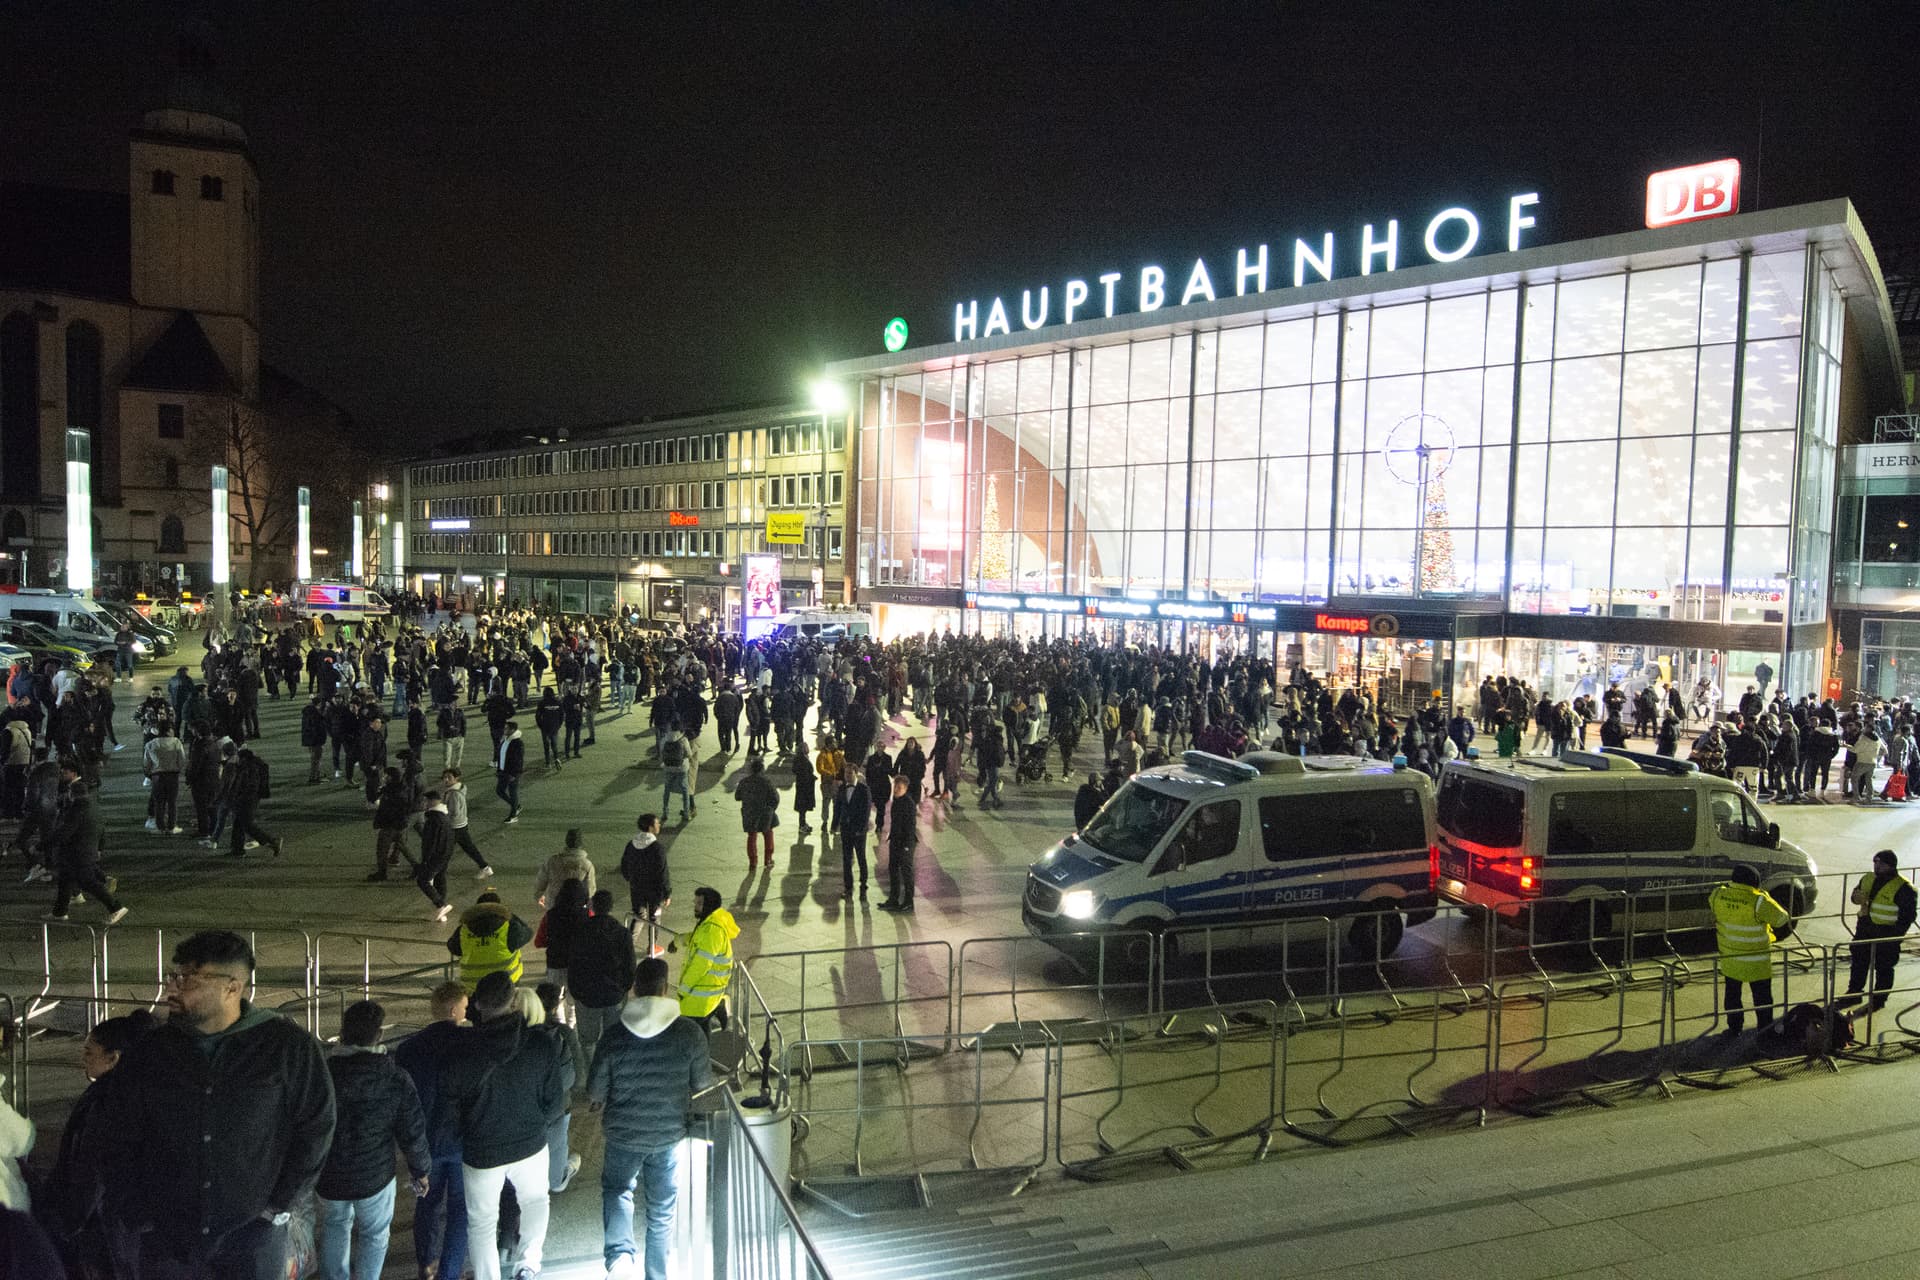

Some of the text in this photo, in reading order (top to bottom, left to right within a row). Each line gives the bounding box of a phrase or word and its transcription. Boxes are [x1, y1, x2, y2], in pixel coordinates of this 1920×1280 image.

[1662, 174, 1726, 216] DB
[954, 192, 1540, 343] HAUPTBAHNHOF
[886, 320, 905, 349] S
[670, 512, 684, 526] ibis
[1316, 613, 1369, 633] Kamps
[1275, 887, 1324, 902] POLIZEI
